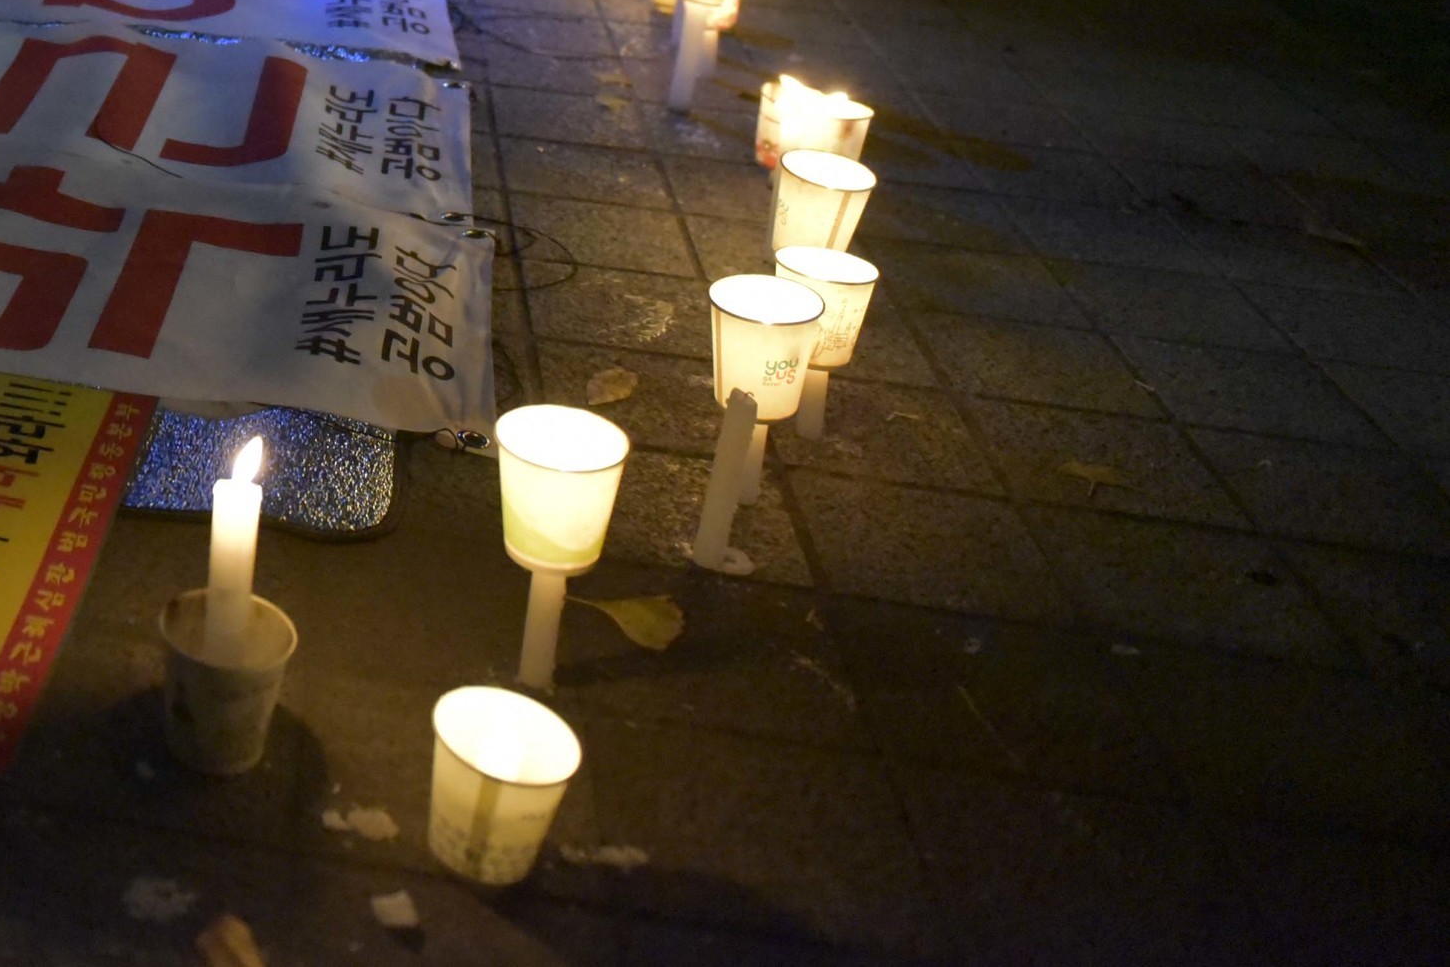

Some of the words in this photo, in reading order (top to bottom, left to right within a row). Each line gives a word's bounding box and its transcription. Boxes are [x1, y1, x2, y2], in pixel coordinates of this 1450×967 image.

[382, 96, 442, 181] 공범이다
[295, 226, 382, 366] #새누리도
[382, 246, 457, 381] 공범이다
